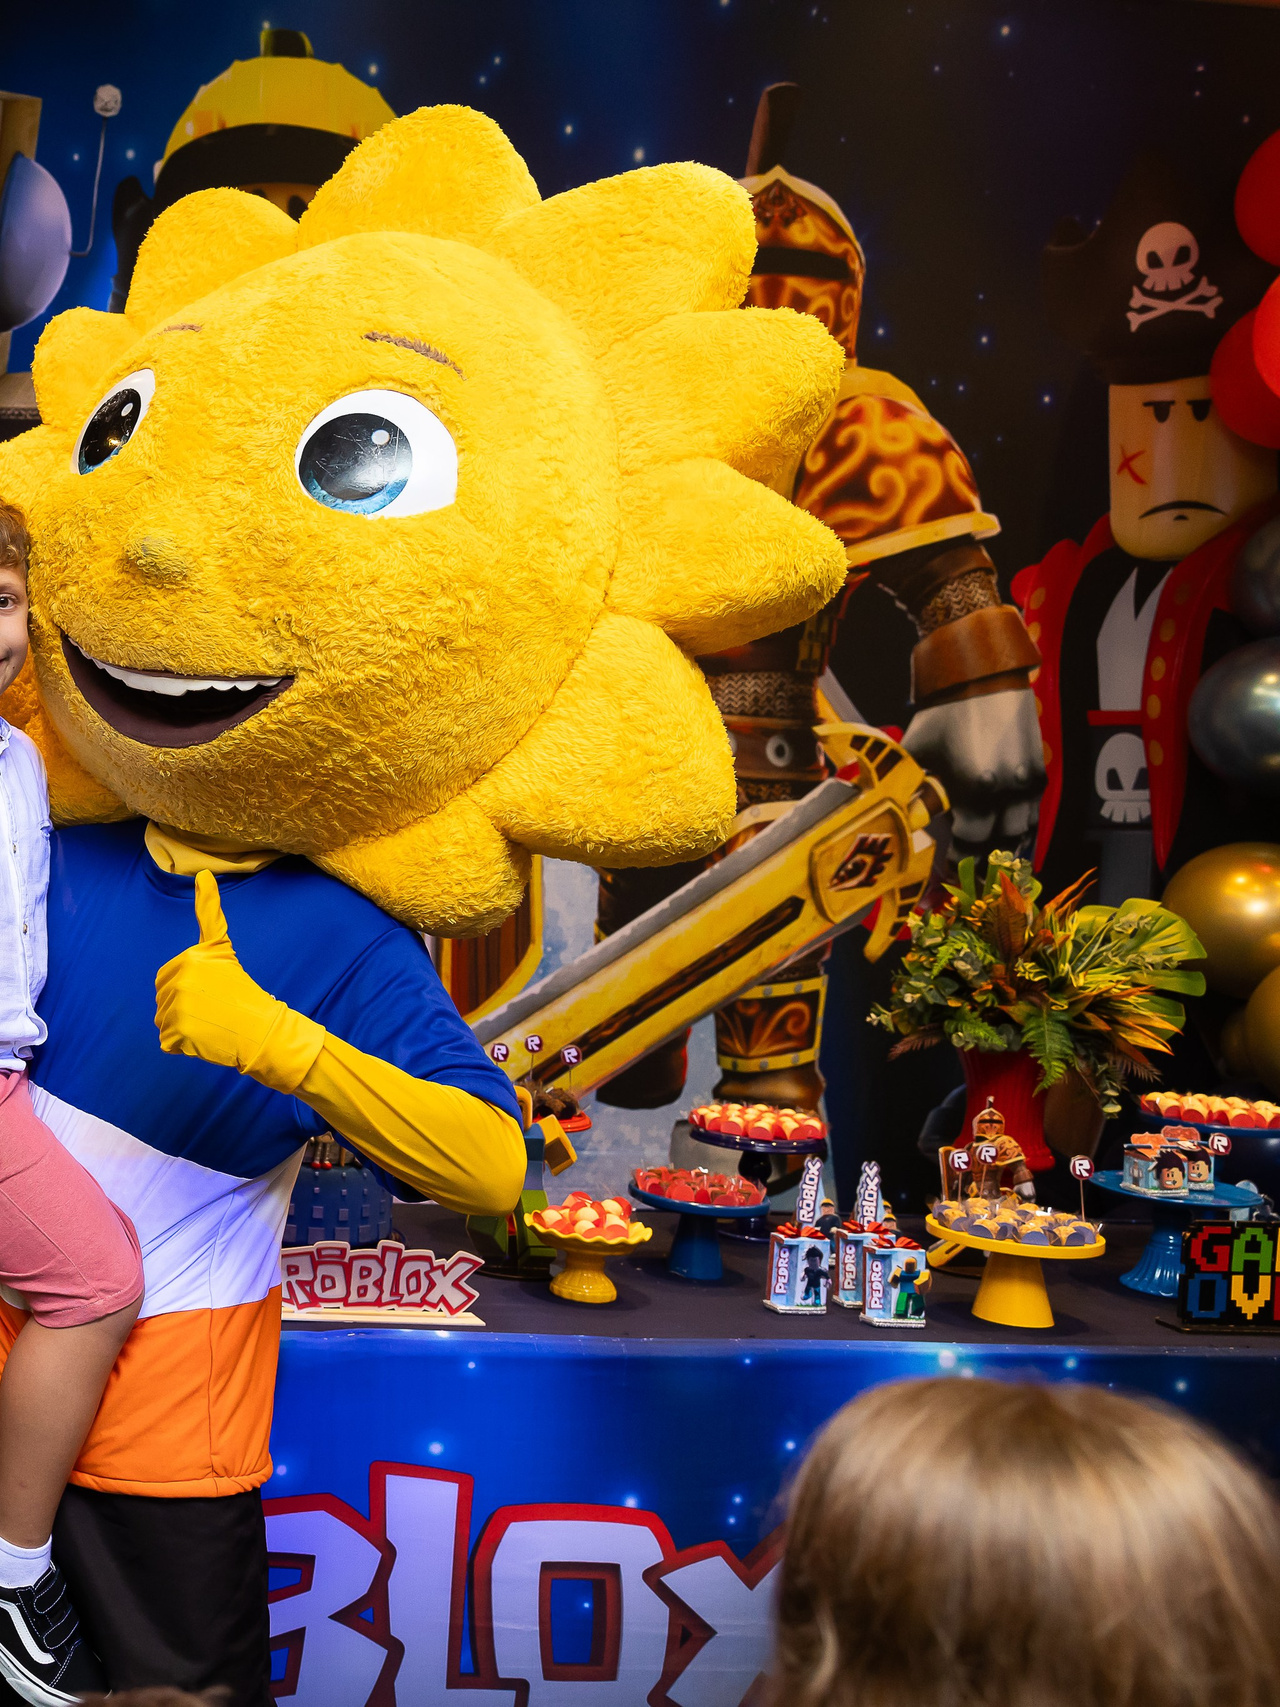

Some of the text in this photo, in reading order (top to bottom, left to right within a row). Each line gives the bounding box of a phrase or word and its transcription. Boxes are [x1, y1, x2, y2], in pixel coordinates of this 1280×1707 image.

[953, 1152, 969, 1169] R
[980, 1146, 996, 1162] R
[1075, 1159, 1091, 1176] R
[1213, 1136, 1229, 1152] R
[858, 1174, 882, 1230] OBLOX
[774, 1246, 790, 1294] PEDRO
[843, 1242, 857, 1290] PEDRO
[1190, 1225, 1280, 1273] GA
[282, 1246, 482, 1314] ROBLOX
[869, 1259, 884, 1309] PEDRO
[1187, 1272, 1280, 1320] OV
